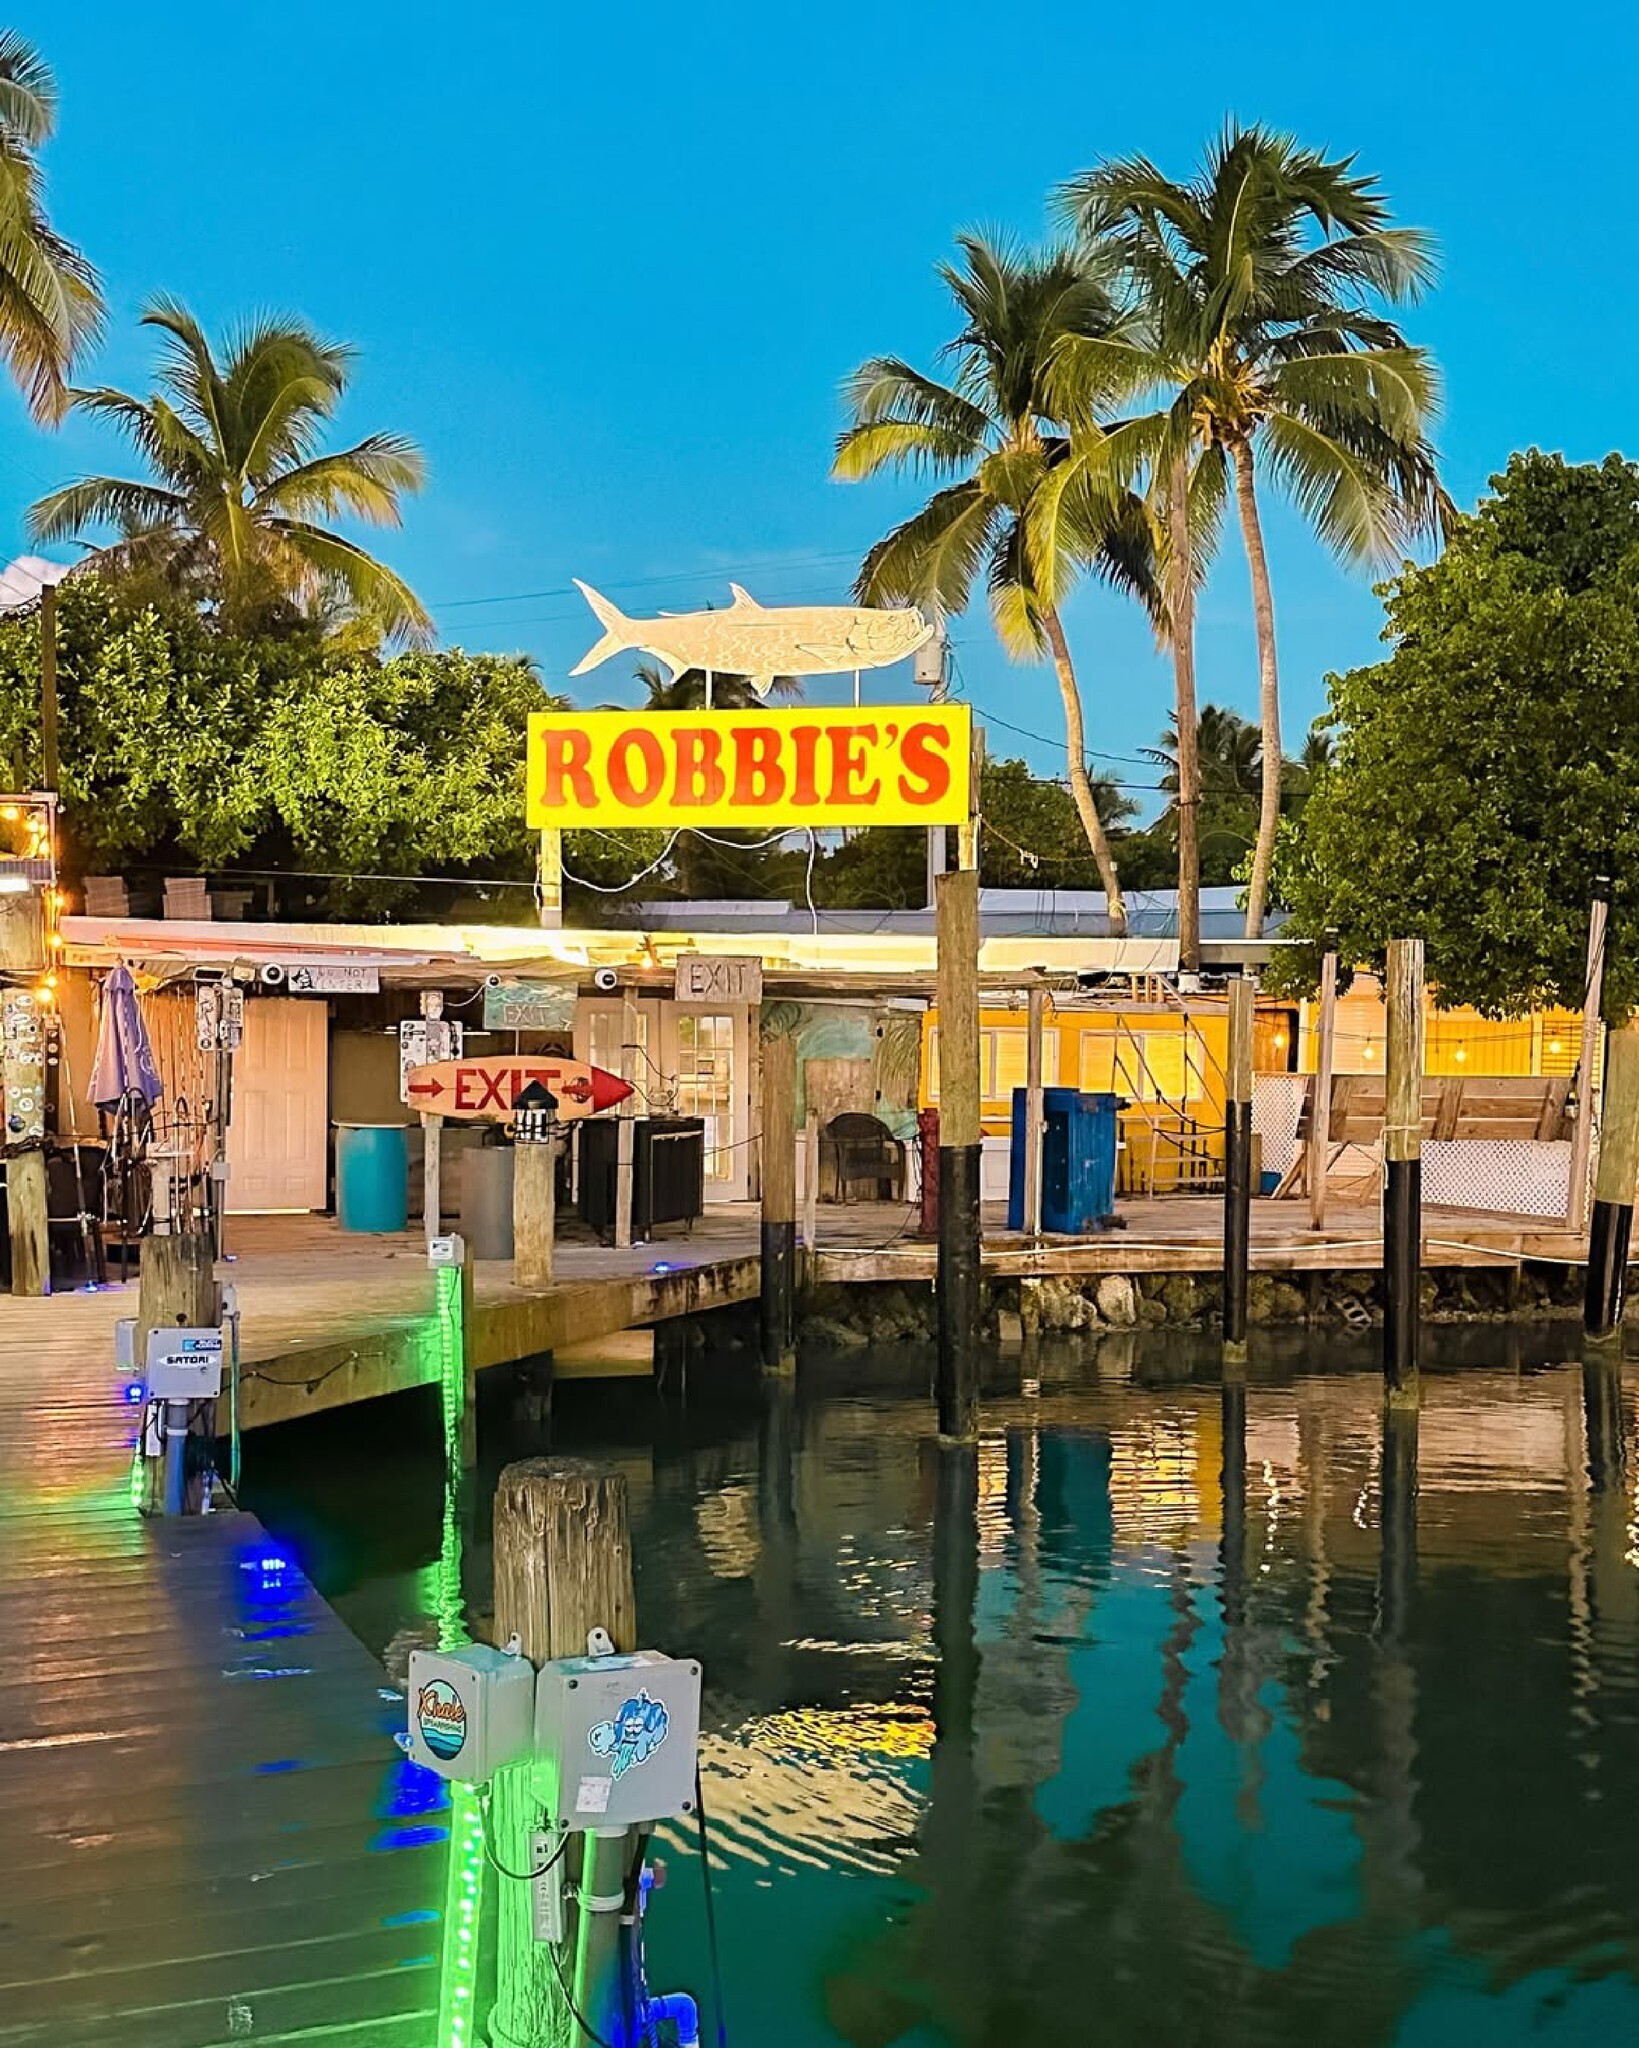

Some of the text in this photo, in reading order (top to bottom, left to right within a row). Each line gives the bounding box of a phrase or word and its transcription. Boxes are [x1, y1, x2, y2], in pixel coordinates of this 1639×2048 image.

[541, 722, 951, 809] ROBBIE'S
[689, 963, 748, 994] EXIT
[503, 1003, 551, 1025] EXIT
[454, 1068, 561, 1110] EXIT
[167, 1356, 209, 1365] SATORI
